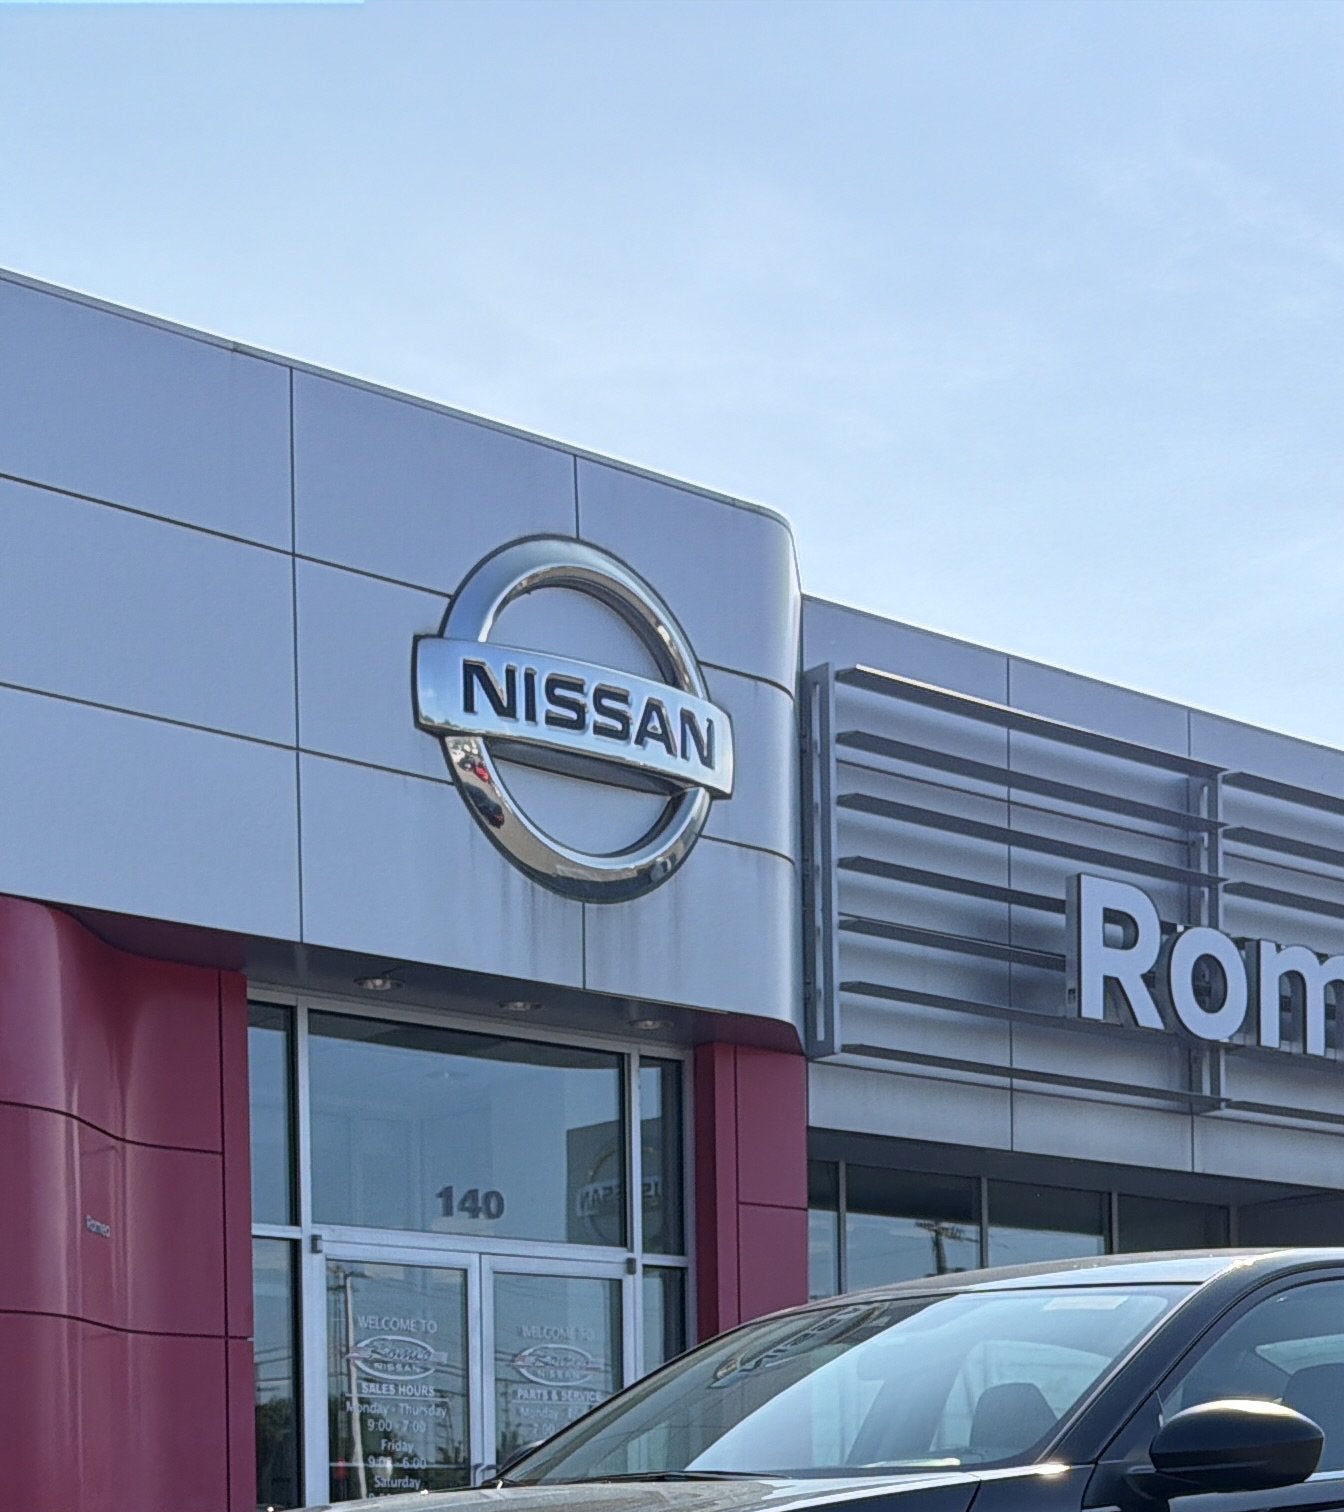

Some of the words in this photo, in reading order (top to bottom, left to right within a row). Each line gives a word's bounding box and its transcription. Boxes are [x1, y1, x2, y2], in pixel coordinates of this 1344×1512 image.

[462, 658, 716, 770] NISSAN
[436, 1186, 505, 1220] 140
[357, 1315, 417, 1331] WELCOME
[421, 1319, 438, 1333] TO
[520, 1325, 578, 1339] WELCOME
[361, 1383, 395, 1395] SALES
[398, 1385, 435, 1397] HOURS
[517, 1388, 548, 1400] PARTS
[562, 1391, 603, 1403] SERVICE
[346, 1400, 390, 1417] Monday
[399, 1403, 448, 1418] Thursday
[367, 1419, 393, 1432] 9:00
[402, 1420, 427, 1433] 7:00
[381, 1439, 416, 1454] Friday
[374, 1475, 422, 1490] Saturday
